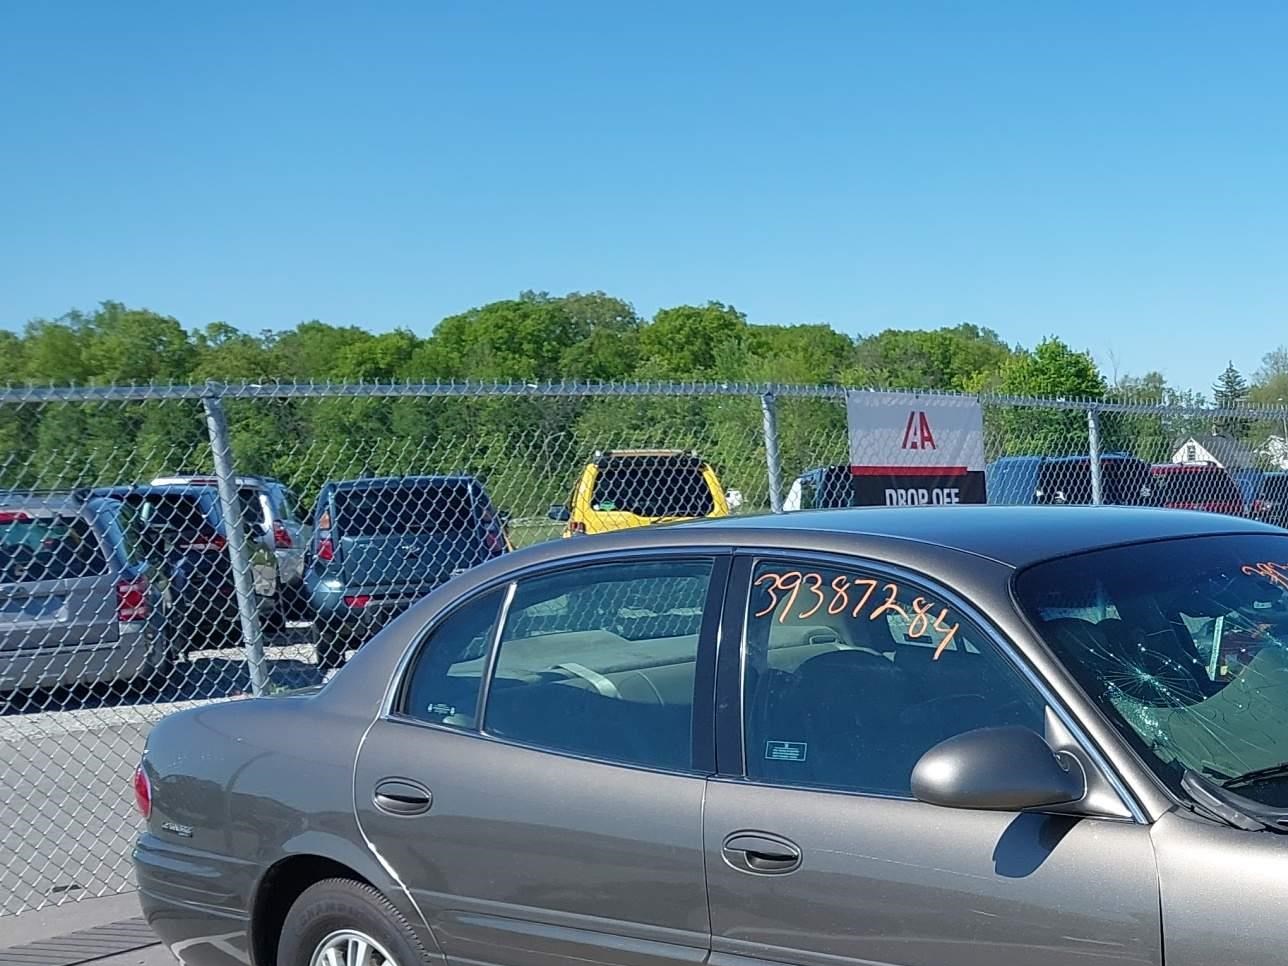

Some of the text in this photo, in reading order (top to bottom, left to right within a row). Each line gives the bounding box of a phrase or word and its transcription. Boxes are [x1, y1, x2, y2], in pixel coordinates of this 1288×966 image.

[885, 488, 960, 506] DROP OFF
[754, 571, 959, 661] 39387284
